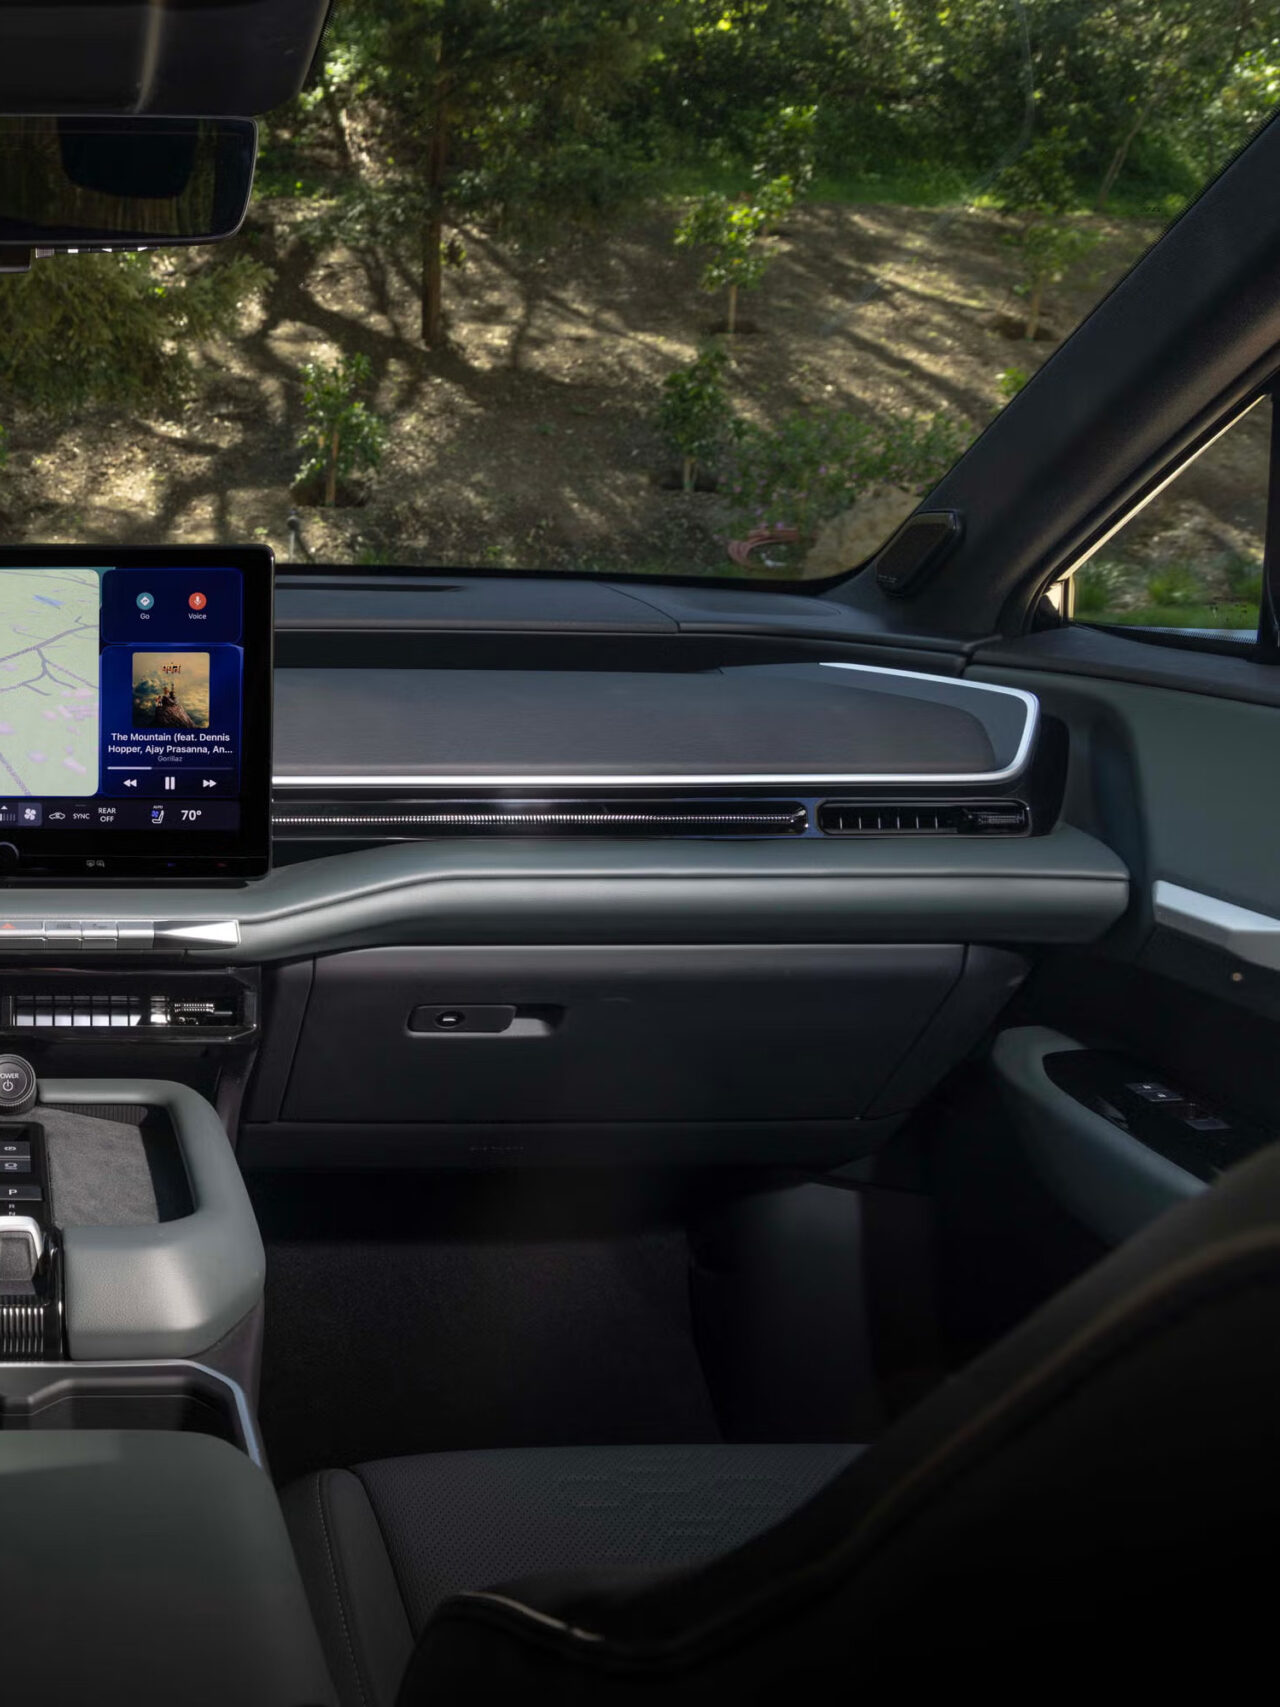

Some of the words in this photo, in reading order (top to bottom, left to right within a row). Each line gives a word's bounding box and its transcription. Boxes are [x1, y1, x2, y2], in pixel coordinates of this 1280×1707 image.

[111, 733, 128, 741] The
[130, 733, 171, 741] Mountain
[174, 733, 197, 742] (feat.
[199, 733, 230, 741] Dennis
[108, 745, 143, 754] Hopper,
[145, 745, 164, 754] Ajay
[166, 745, 210, 754] Prasanna,
[212, 745, 233, 753] An...
[98, 807, 116, 815] REAR
[181, 810, 202, 821] 70°
[100, 815, 114, 823] OFF
